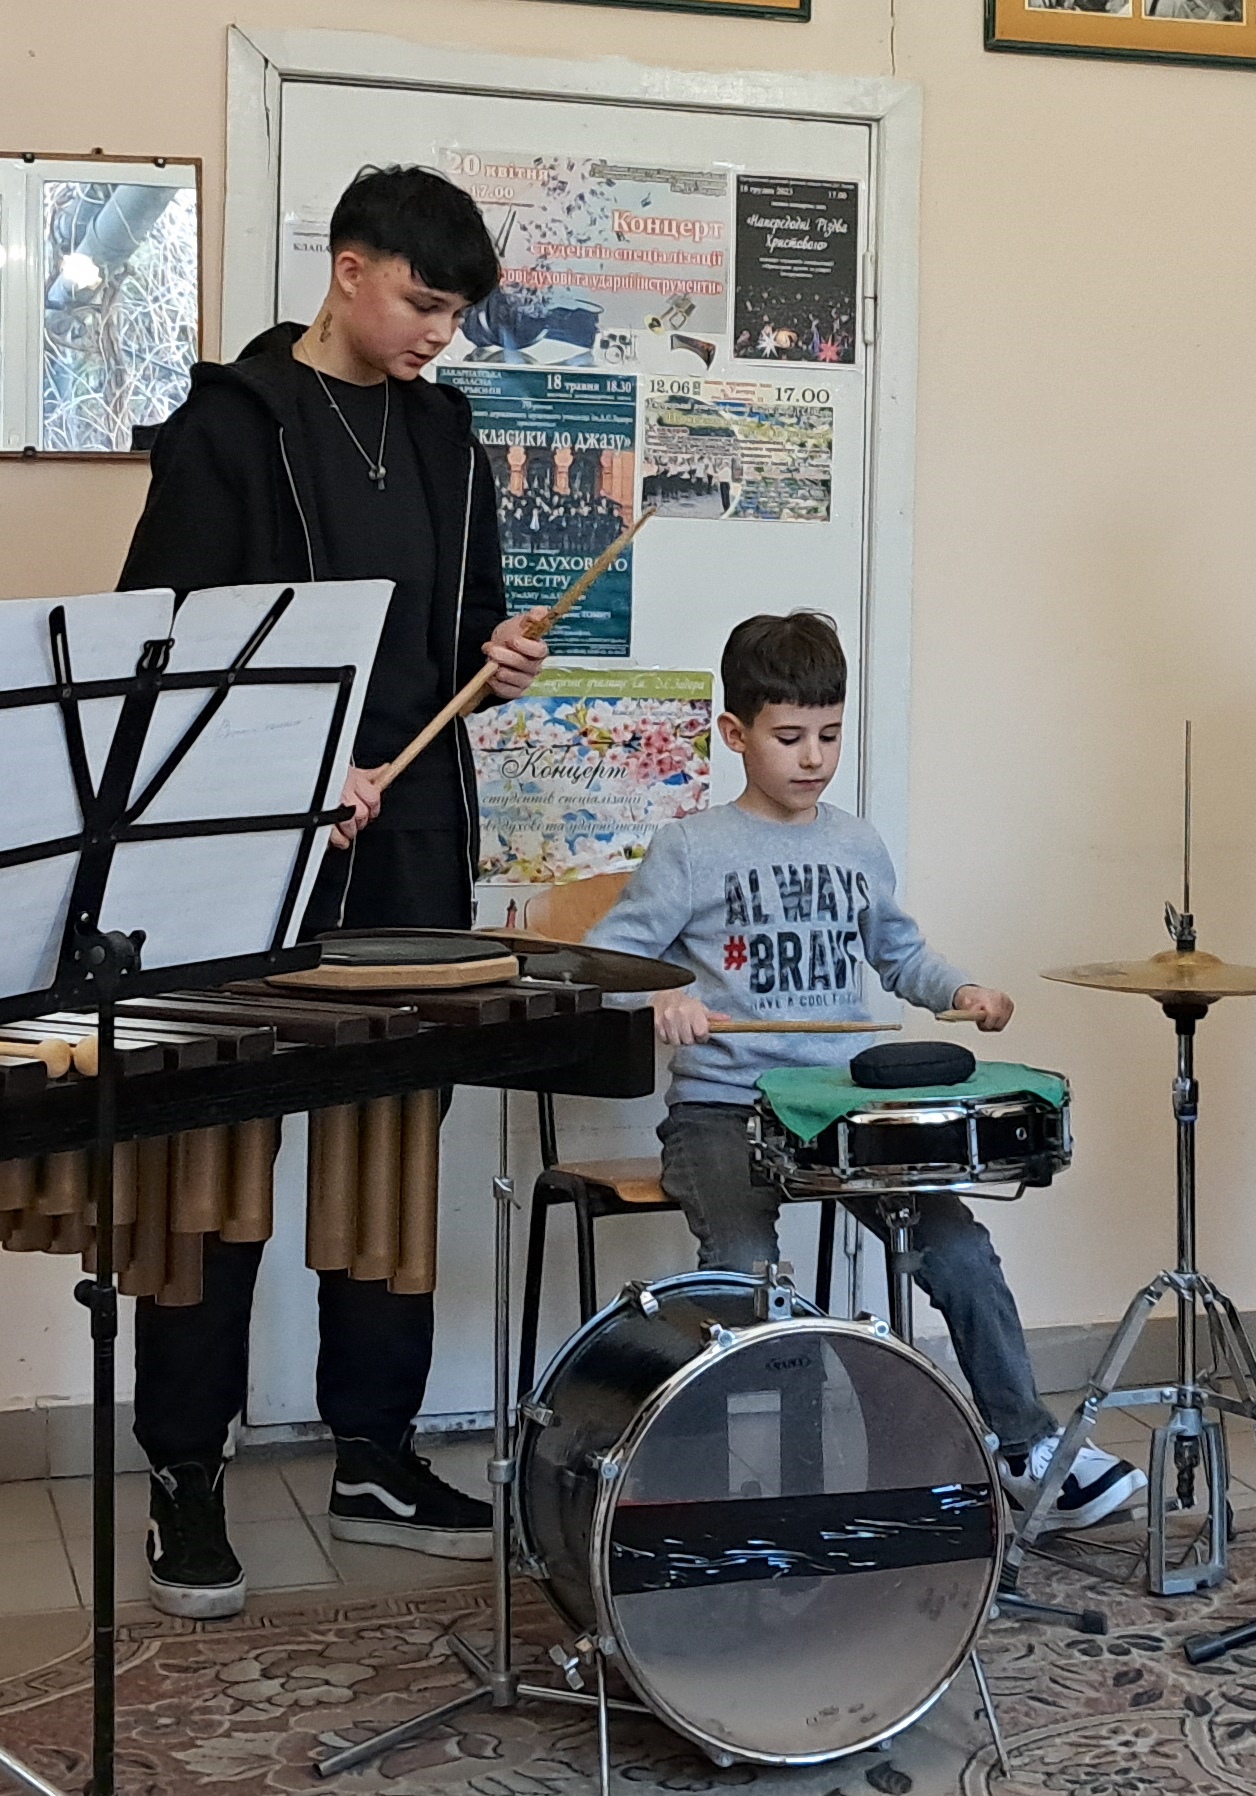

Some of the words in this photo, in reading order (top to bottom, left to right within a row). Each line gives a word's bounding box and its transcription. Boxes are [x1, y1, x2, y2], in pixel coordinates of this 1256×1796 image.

[448, 152, 481, 176] 20
[484, 165, 550, 182] квітня
[612, 210, 726, 243] Концерт
[614, 248, 725, 267] спеціалізації
[547, 374, 562, 389] 18
[606, 380, 633, 393] 18.30
[650, 379, 691, 395] 12.06
[774, 387, 831, 404] 17.00
[503, 574, 571, 590] РКЕСТРУ
[502, 747, 628, 789] Концерт
[724, 863, 870, 927] ALWAYS
